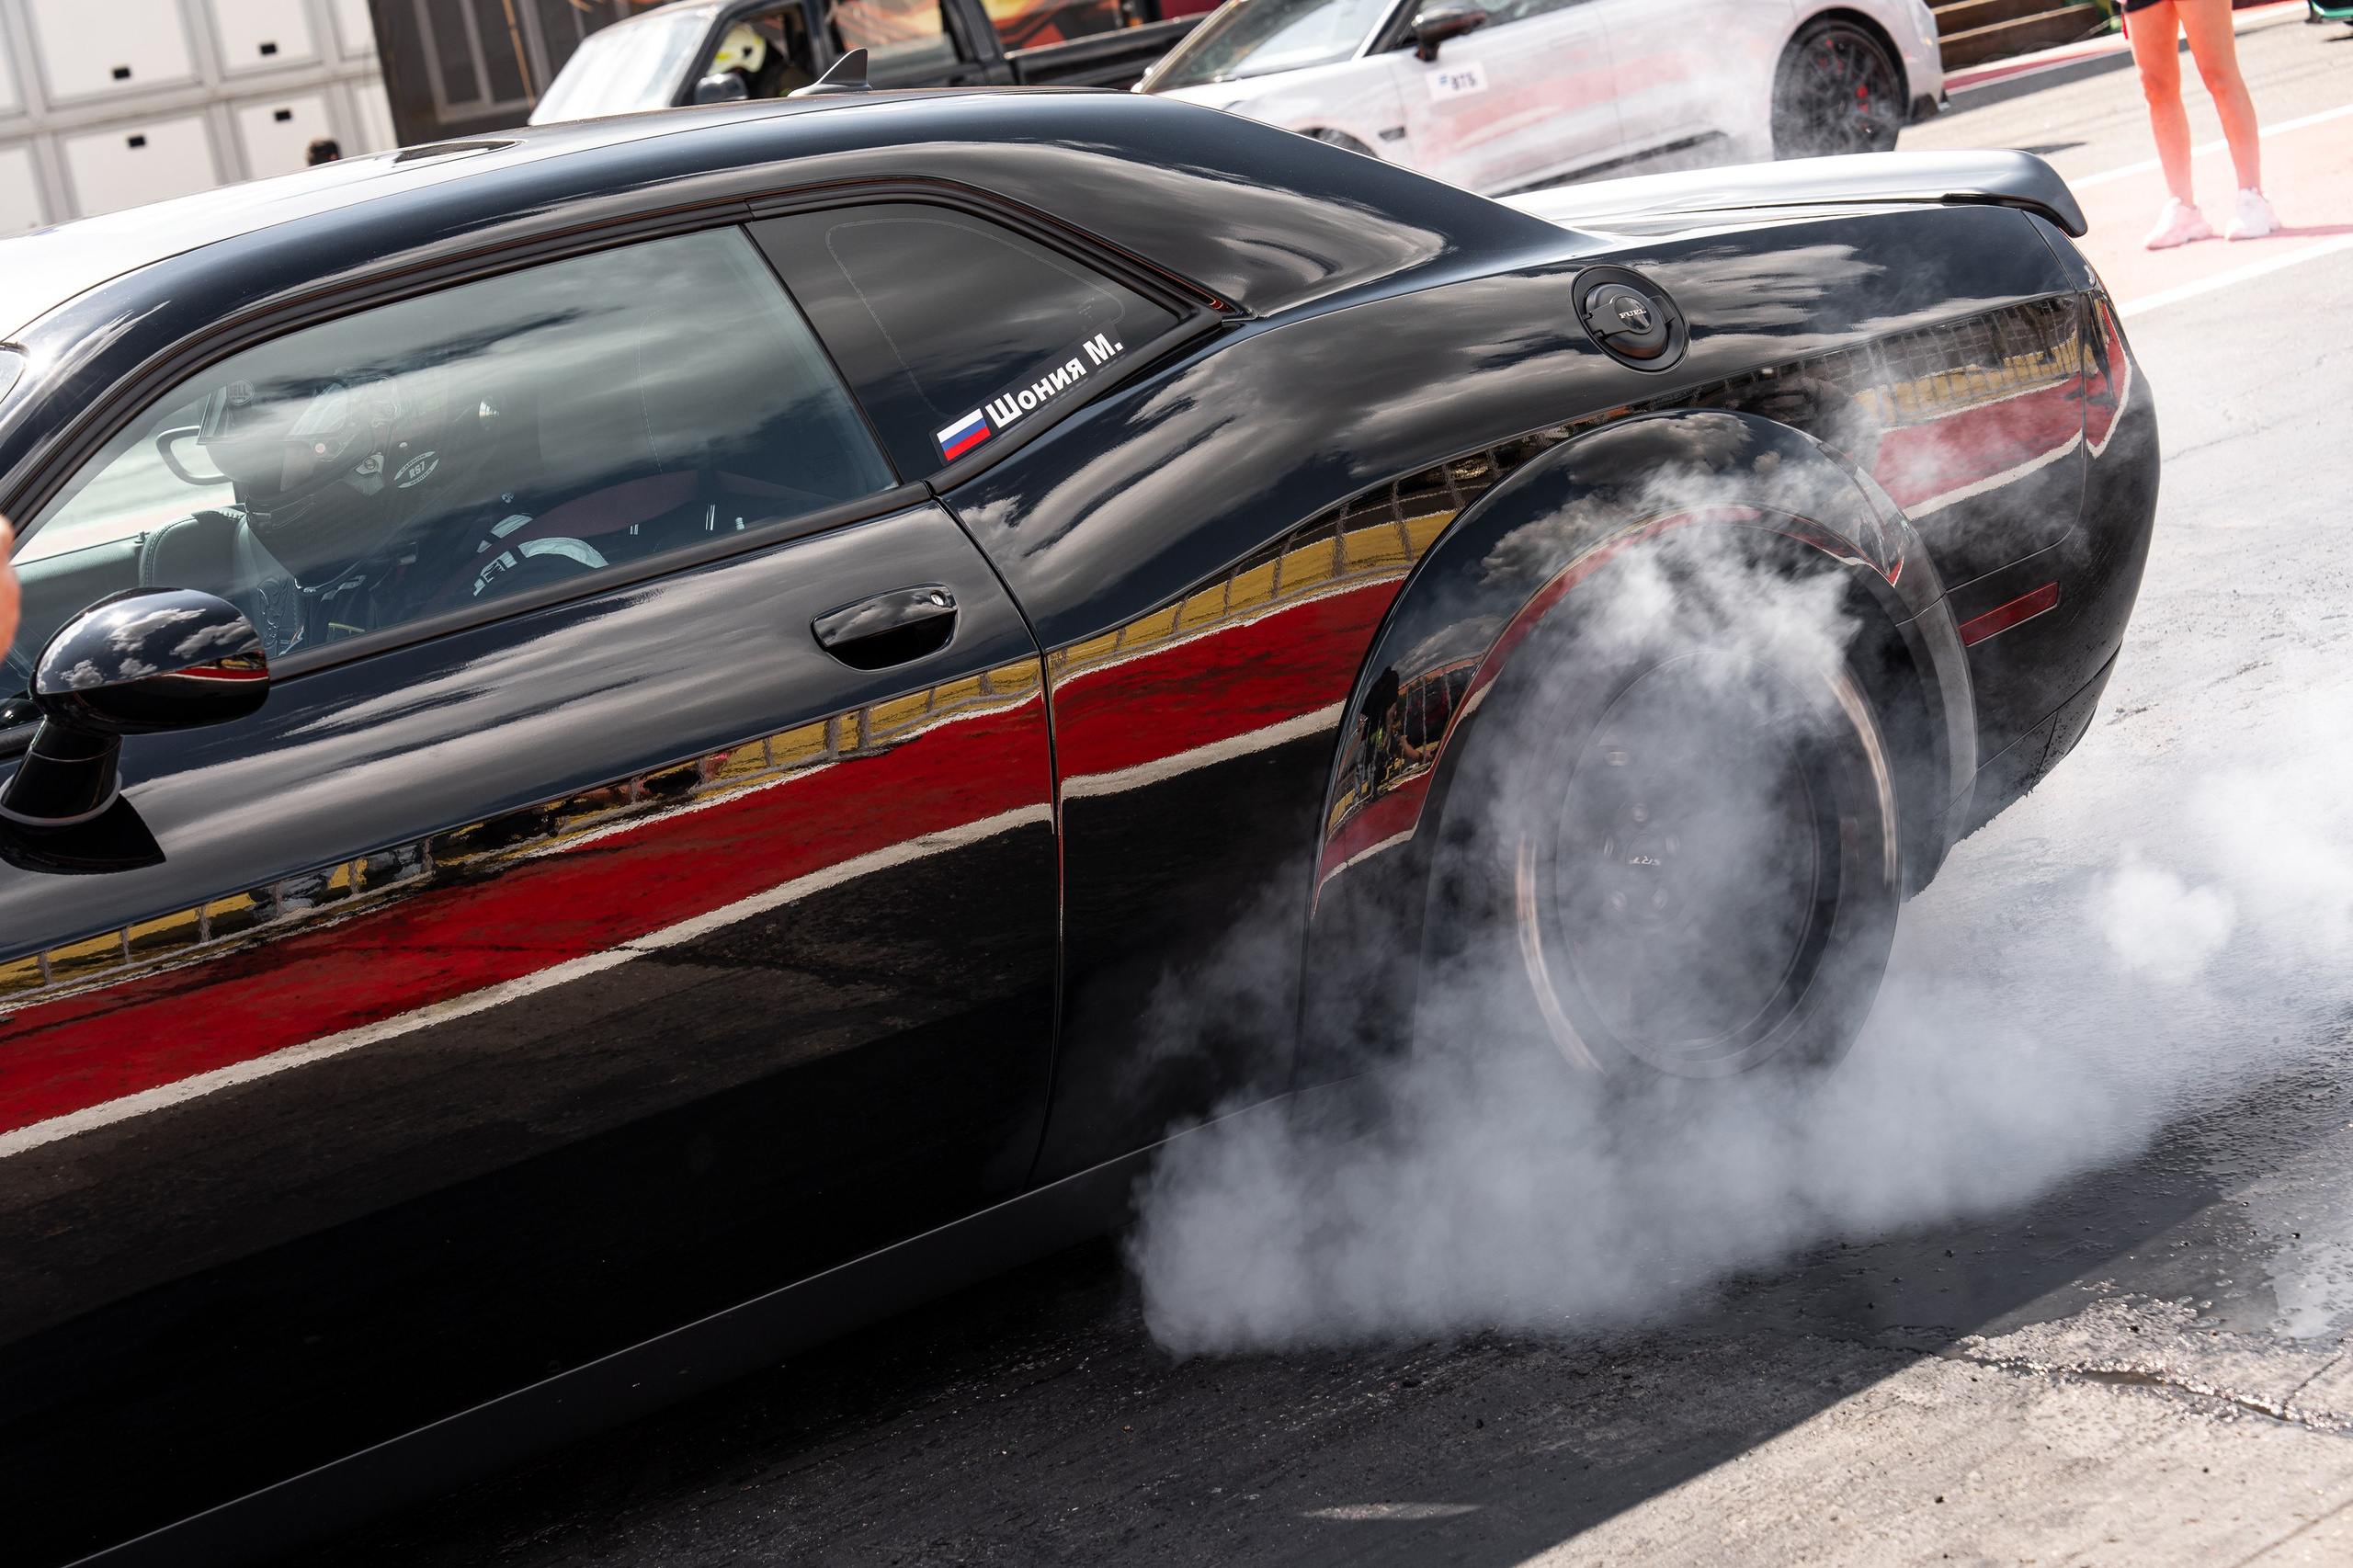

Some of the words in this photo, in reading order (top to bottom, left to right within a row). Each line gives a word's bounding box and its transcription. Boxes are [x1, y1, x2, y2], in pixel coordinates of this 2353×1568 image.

[1619, 308, 1647, 319] FUEL
[230, 384, 249, 396] BELL
[984, 357, 1087, 429] Шония
[1082, 332, 1124, 366] М.
[400, 453, 426, 473] CARBON
[408, 460, 426, 479] RS7
